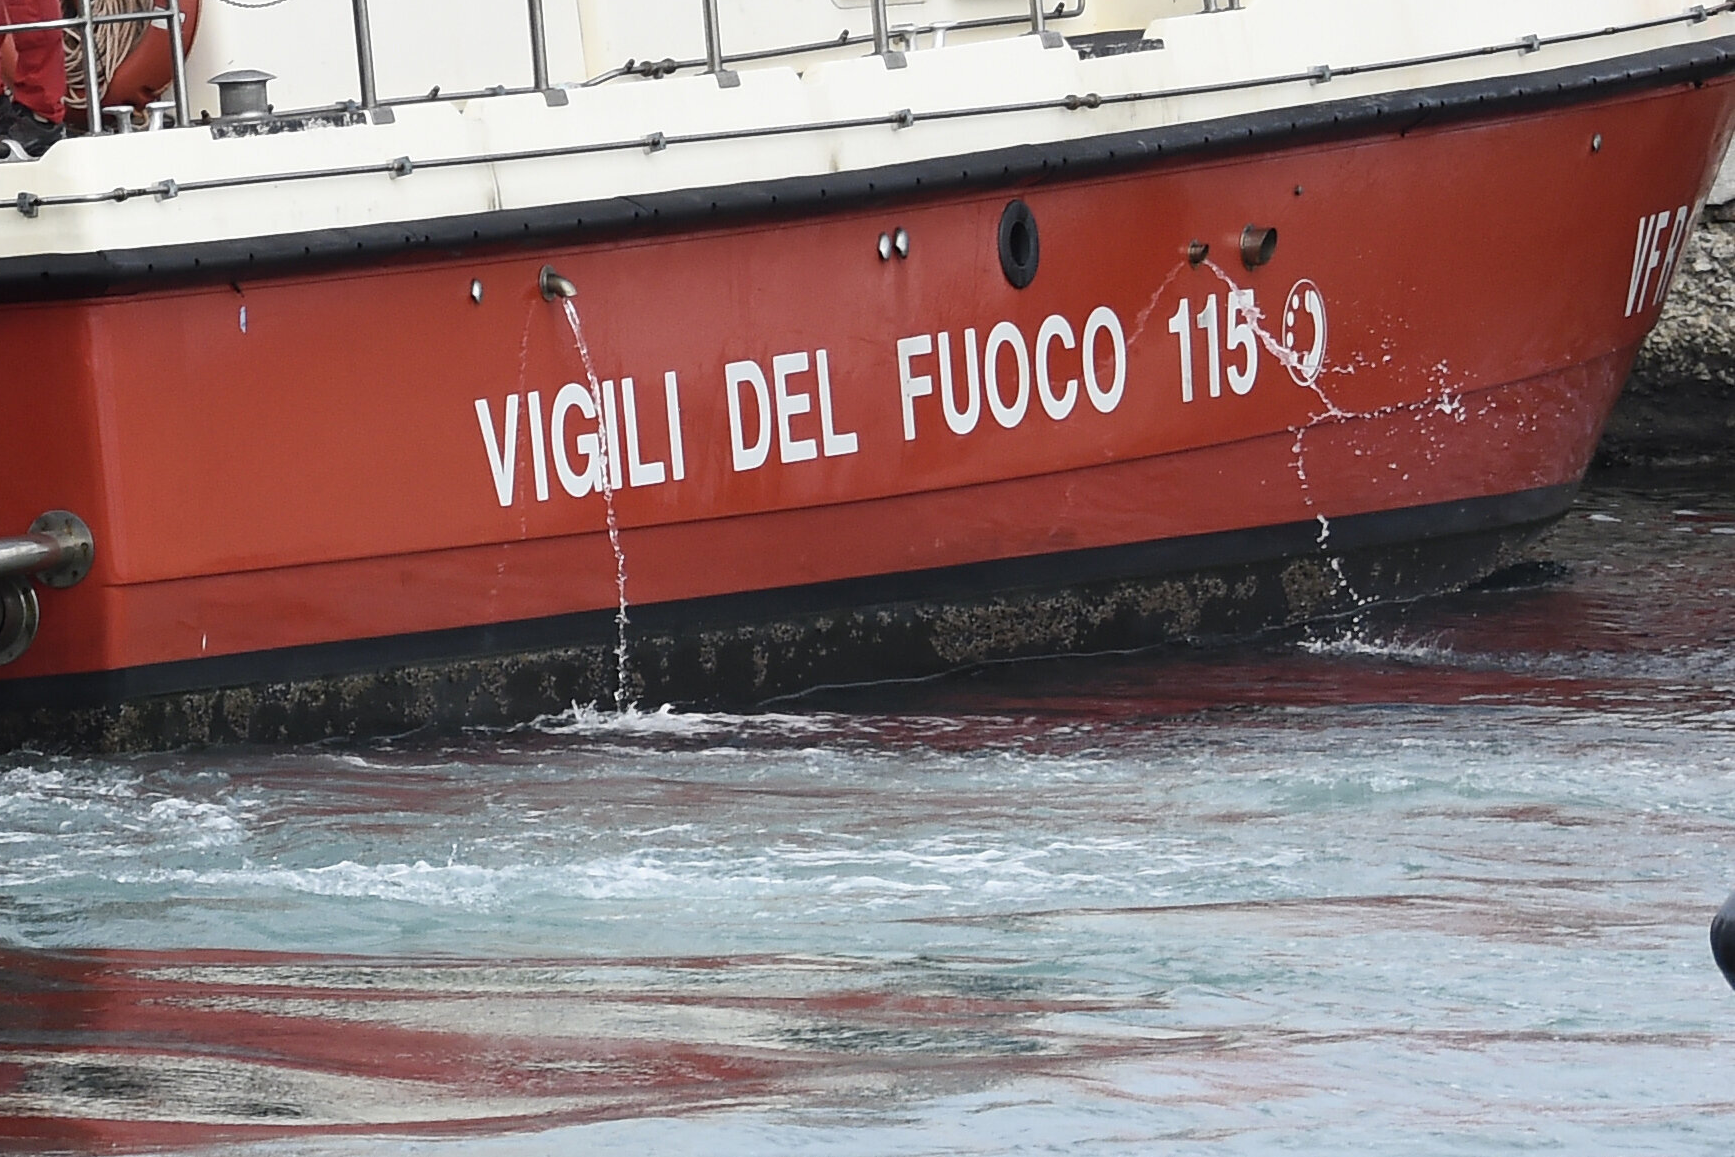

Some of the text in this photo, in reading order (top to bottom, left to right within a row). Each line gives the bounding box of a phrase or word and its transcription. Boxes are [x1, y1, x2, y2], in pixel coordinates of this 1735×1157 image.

[474, 288, 1258, 507] VIGILI DEL FUOCO 115
